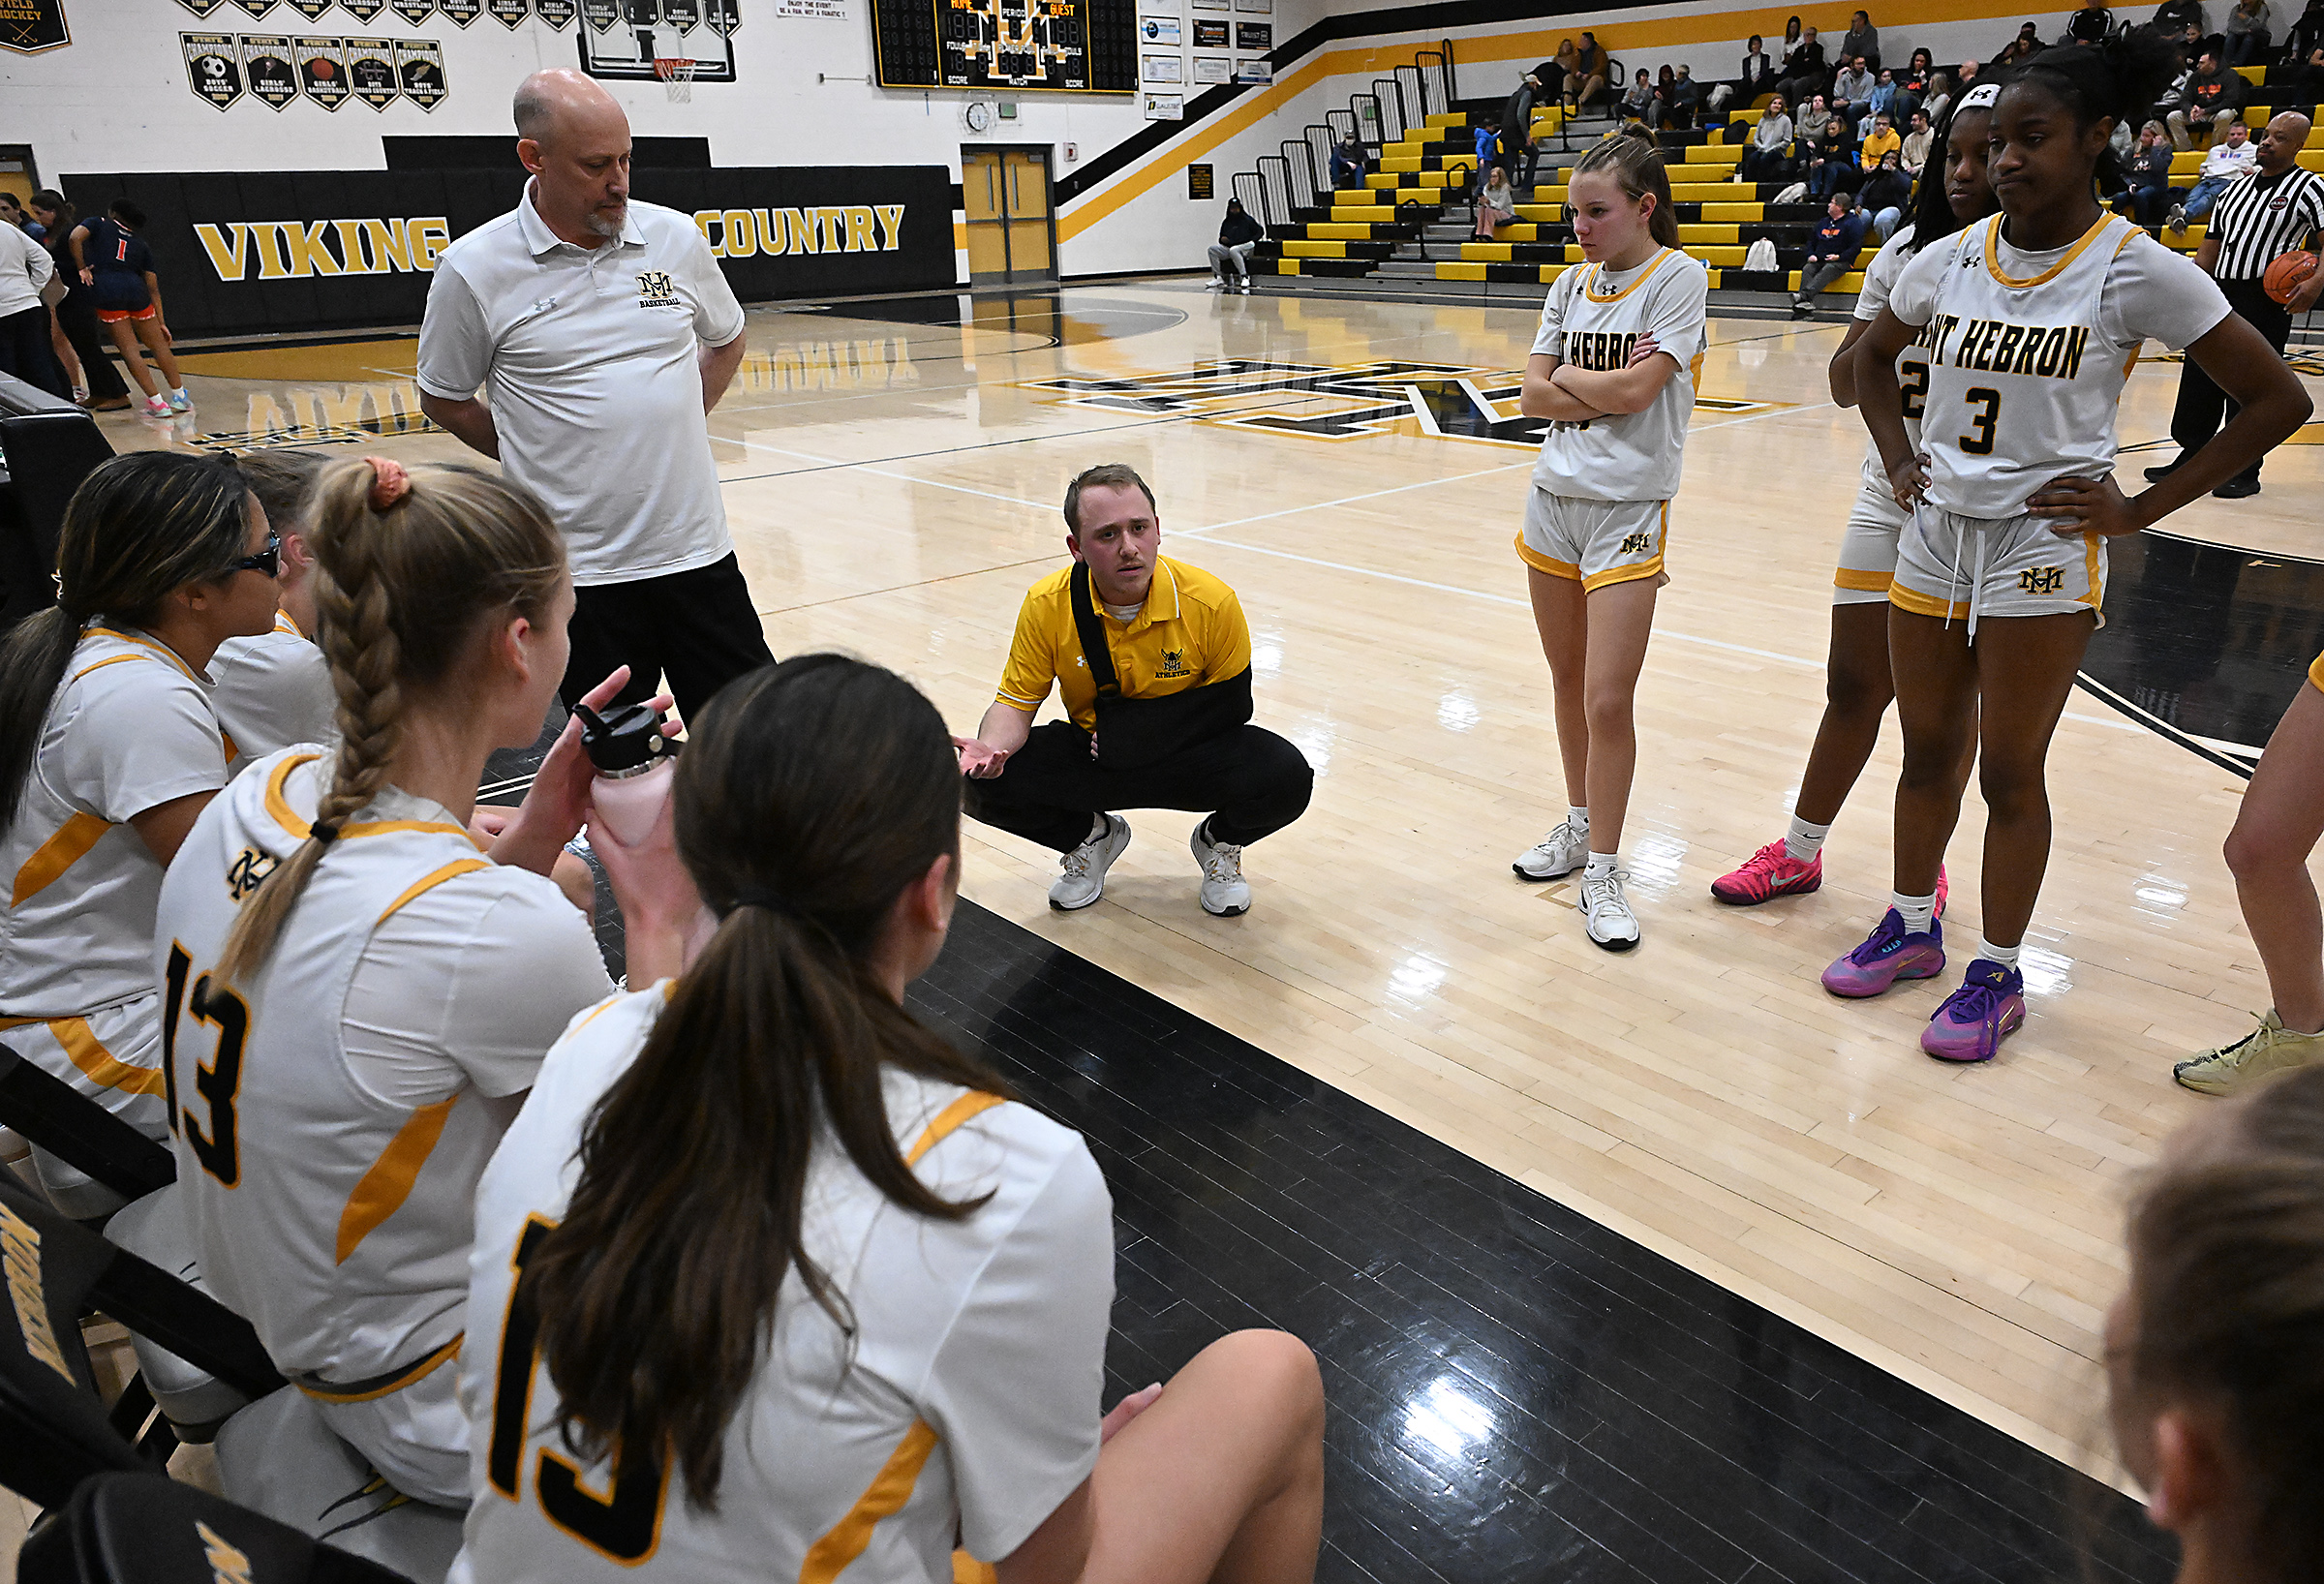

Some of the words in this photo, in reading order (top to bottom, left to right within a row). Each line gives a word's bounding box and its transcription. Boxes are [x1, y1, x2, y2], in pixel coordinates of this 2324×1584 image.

[443, 3, 477, 12] LACROSSE
[1002, 8, 1025, 17] PERIOD
[1050, 4, 1075, 16] GUEST
[948, 76, 967, 84] SCORE
[1008, 77, 1027, 86] MATCH
[1065, 79, 1084, 88] SCORE
[639, 297, 681, 309] BASKETBALL
[1954, 318, 2091, 381] HEBRON
[1959, 386, 2002, 455] 3
[1154, 669, 1191, 679] ATHLETICS
[162, 937, 253, 1190] 13
